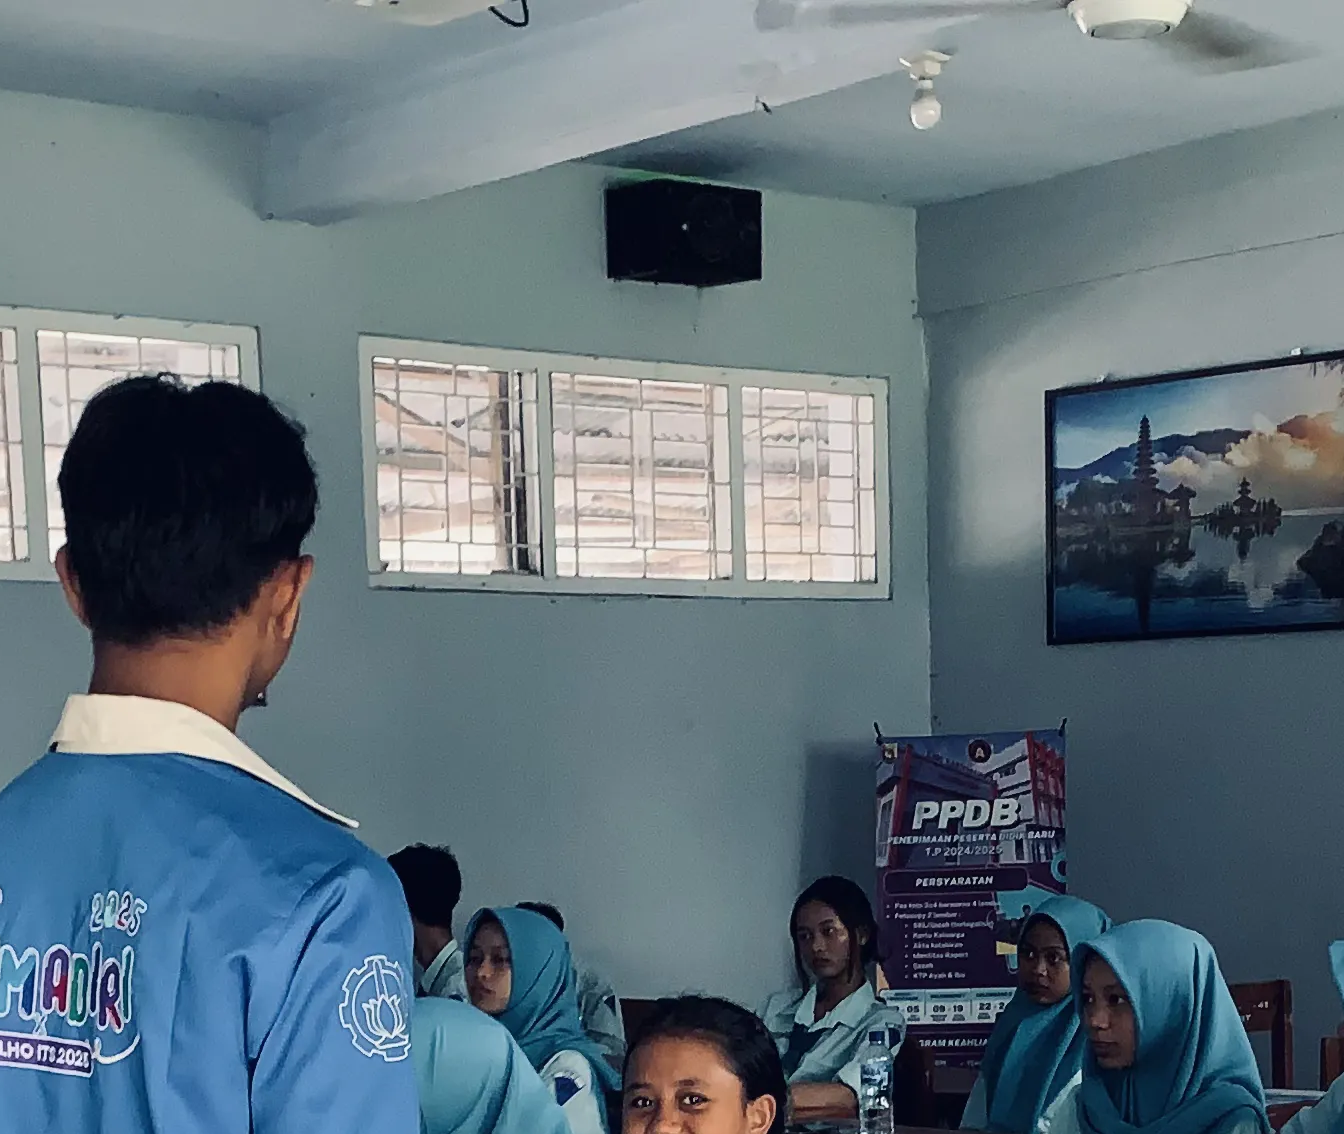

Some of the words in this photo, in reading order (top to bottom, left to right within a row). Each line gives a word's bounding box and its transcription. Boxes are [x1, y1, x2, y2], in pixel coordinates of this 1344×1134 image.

[911, 798, 1022, 830] PPDB
[887, 834, 952, 845] PENERIMAAN
[953, 832, 997, 843] PESERTA
[1027, 830, 1056, 840] BARU
[915, 876, 994, 887] PERSYARATAN
[89, 890, 148, 937] 2025
[36, 1043, 56, 1064] ITS
